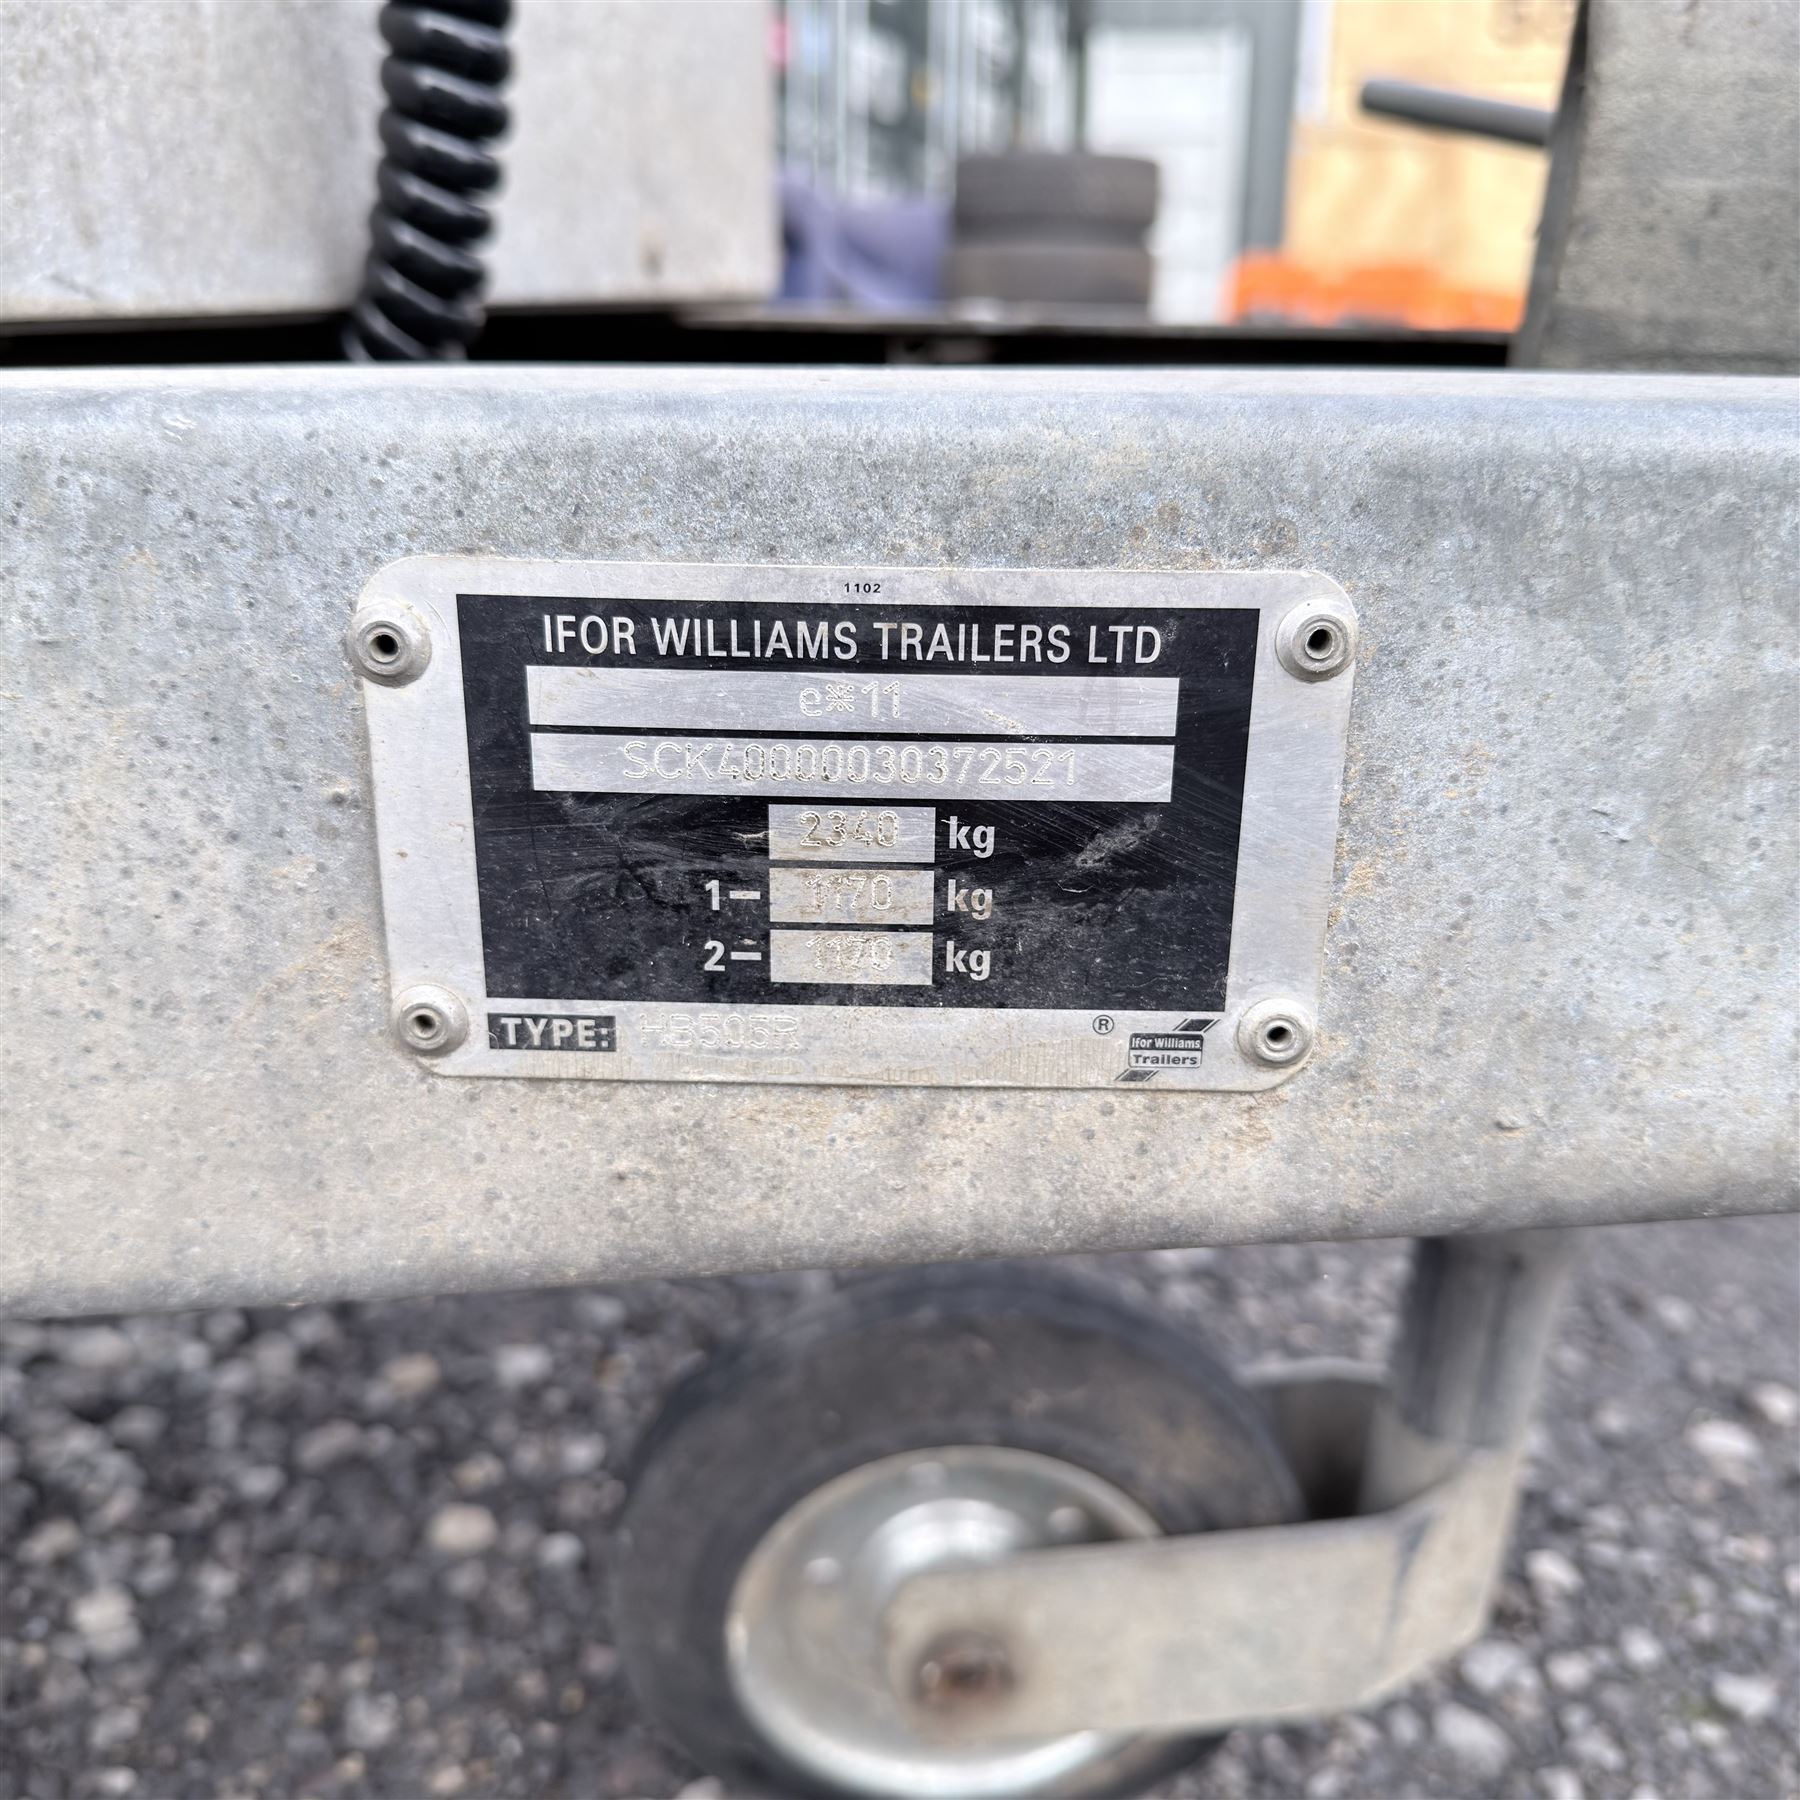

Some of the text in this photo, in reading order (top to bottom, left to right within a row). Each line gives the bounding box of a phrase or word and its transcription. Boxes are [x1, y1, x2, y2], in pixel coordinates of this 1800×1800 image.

[844, 583, 881, 594] 1102
[544, 615, 1162, 665] IFOR WILLIAMS TRAILERS LTD
[623, 740, 1077, 785] SCK40000030372521
[800, 810, 996, 858] 2340 kg
[947, 879, 993, 920] kg
[945, 941, 991, 981] kg
[501, 1017, 609, 1048] TYPE:
[1131, 1037, 1200, 1049] Ifor Williams
[1132, 1054, 1198, 1065] Trailers
